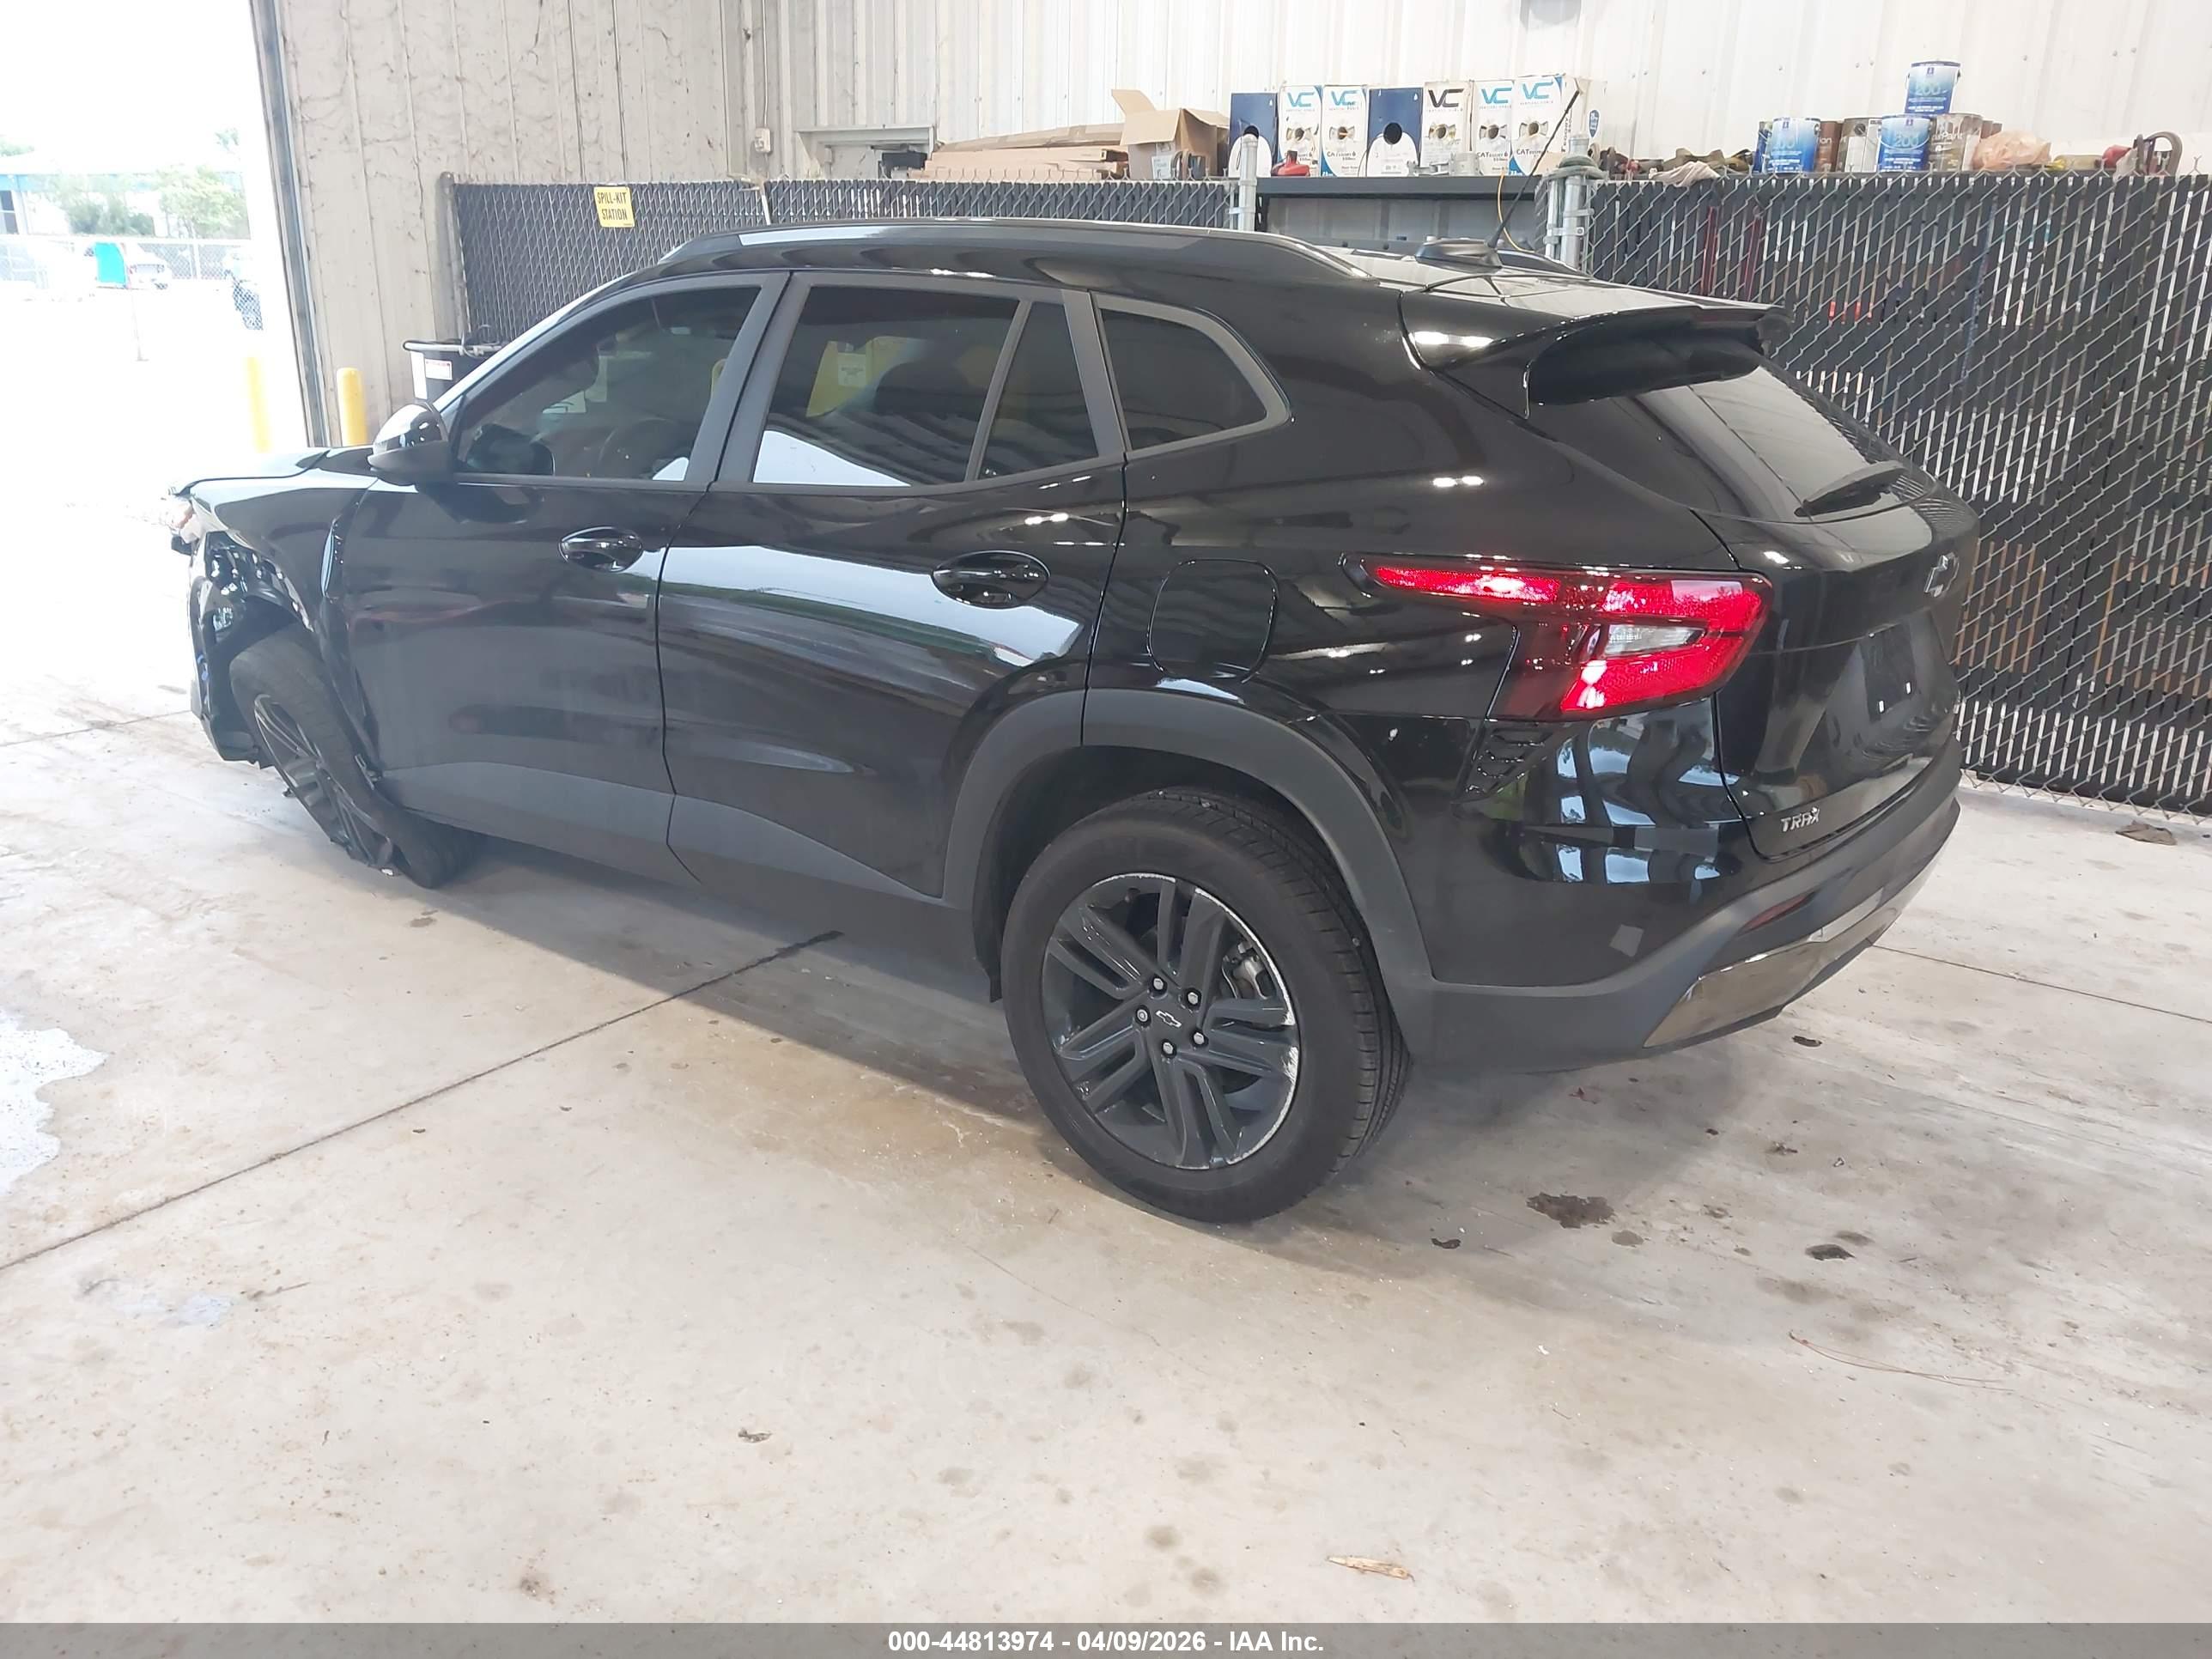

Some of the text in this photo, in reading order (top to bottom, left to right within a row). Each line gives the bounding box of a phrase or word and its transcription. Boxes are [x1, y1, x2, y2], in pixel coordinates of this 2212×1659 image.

[1331, 89, 1358, 106] VC
[1428, 89, 1464, 107] VC
[1481, 88, 1512, 104] VC
[1522, 82, 1554, 100] VC
[1287, 92, 1316, 107] VC
[597, 191, 627, 204] SPILL-KIT
[601, 209, 628, 220] STATION
[1780, 805, 1820, 832] TRAX
